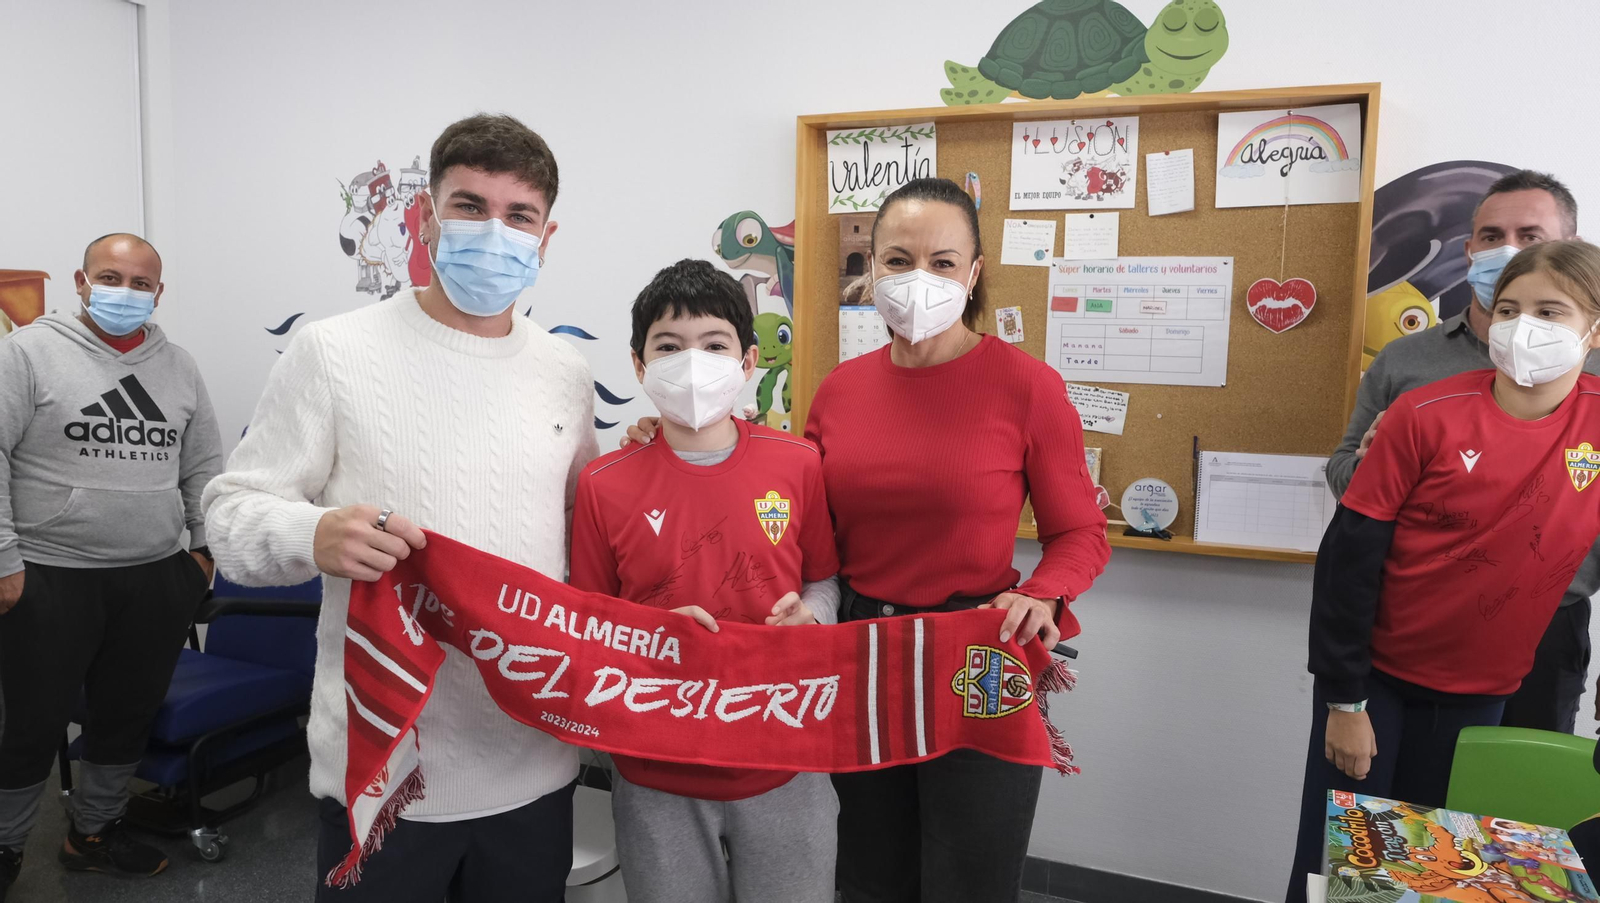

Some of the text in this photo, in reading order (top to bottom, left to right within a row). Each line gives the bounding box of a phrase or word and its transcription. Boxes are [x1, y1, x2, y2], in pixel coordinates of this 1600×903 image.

[1023, 191, 1040, 200] MEJOR
[1042, 191, 1062, 199] EQUIPO
[1058, 263, 1217, 275] Súper horario de talleres y voluntarios
[1165, 328, 1191, 336] Domingo
[1066, 357, 1099, 365] Tarde
[63, 417, 178, 447] adidas
[79, 447, 169, 461] ATHLETICS
[1134, 484, 1167, 497] argar
[497, 583, 681, 664] UD ALMERÍA
[469, 628, 571, 699] DEL
[584, 666, 841, 728] DESIERTO
[988, 657, 1000, 710] ALMERIA
[540, 710, 600, 738] 2023/2024
[1338, 809, 1377, 868] Cocodrilo
[1371, 821, 1406, 861] Tragón
